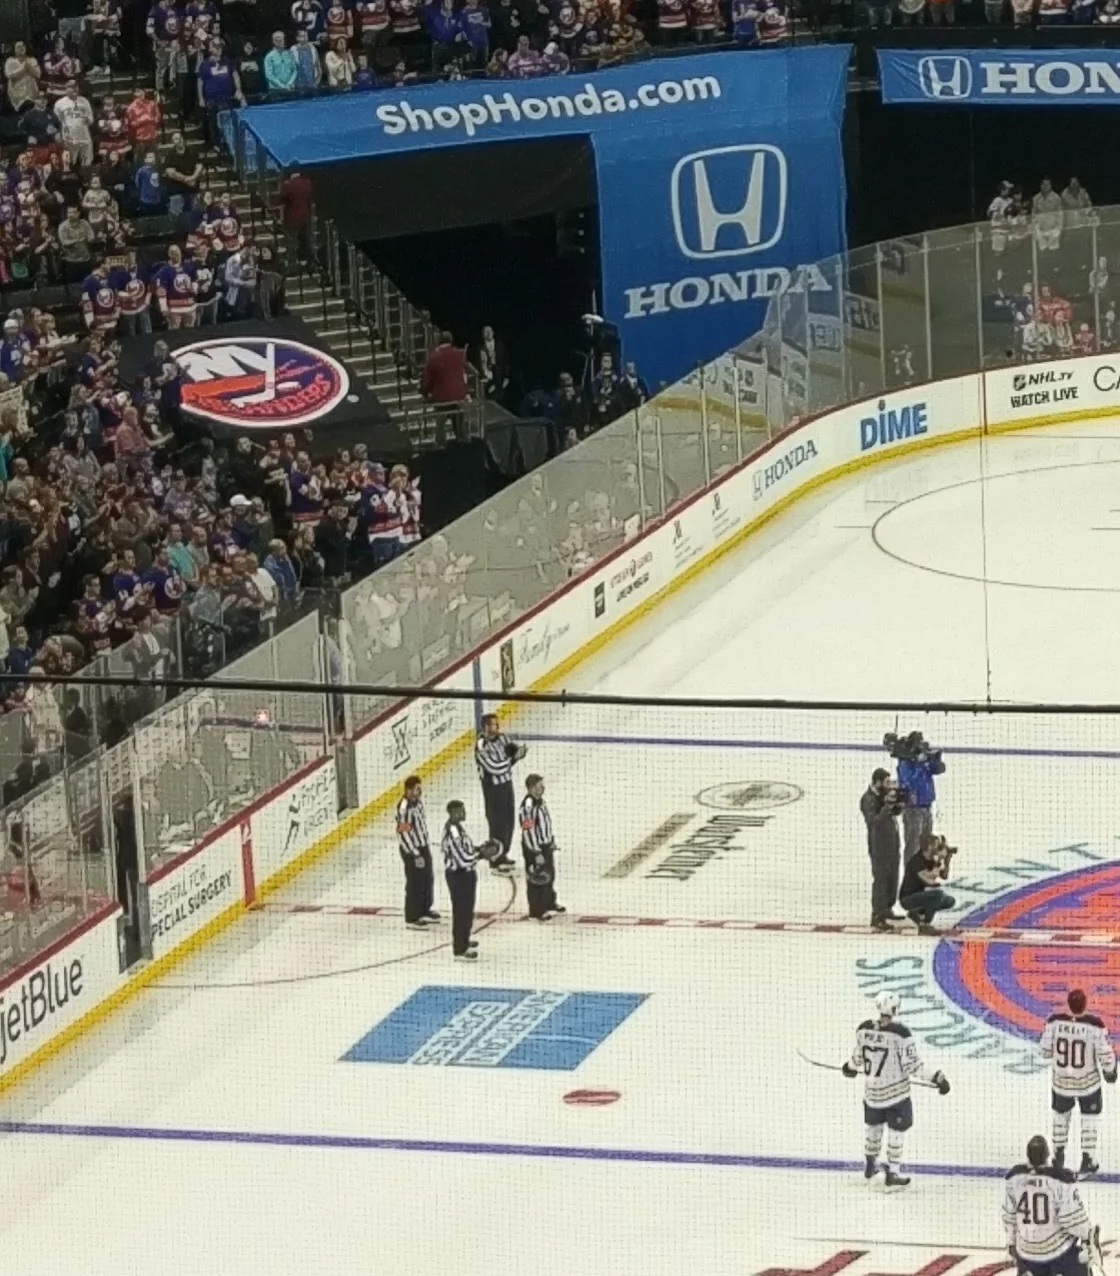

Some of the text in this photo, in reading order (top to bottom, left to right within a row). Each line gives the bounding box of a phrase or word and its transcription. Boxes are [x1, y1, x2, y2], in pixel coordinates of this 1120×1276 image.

[376, 71, 721, 136] ShopHonda.com
[624, 263, 833, 319] HONDA
[1053, 386, 1079, 402] LIVE
[764, 439, 818, 489] HONDA
[151, 867, 188, 918] OSPITAL
[151, 903, 187, 939] PECIAL
[0, 958, 83, 1065] jetBlue
[862, 1044, 889, 1077] 67
[1056, 1037, 1086, 1069] 90
[1016, 1190, 1050, 1225] 40
